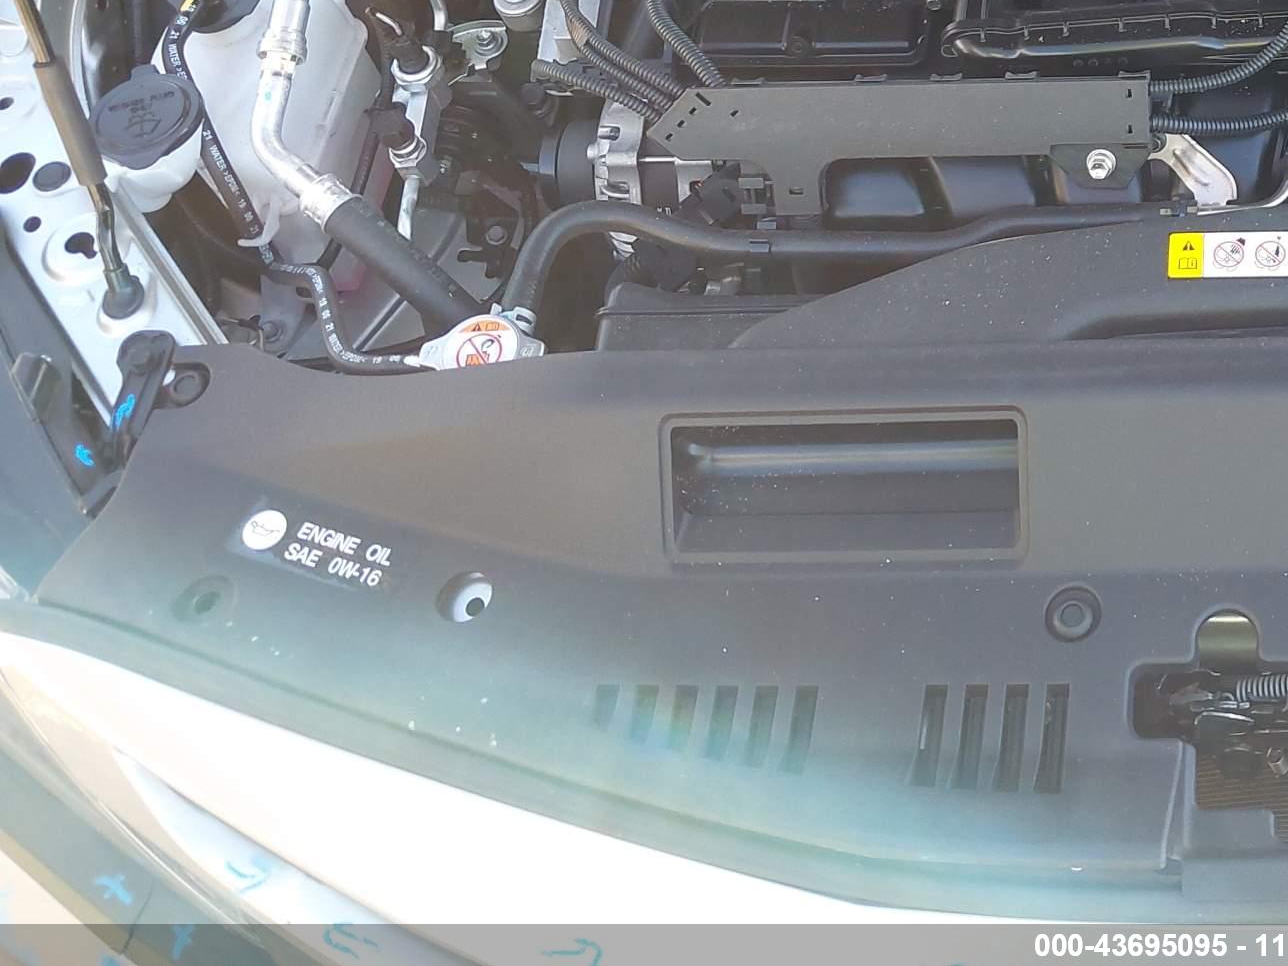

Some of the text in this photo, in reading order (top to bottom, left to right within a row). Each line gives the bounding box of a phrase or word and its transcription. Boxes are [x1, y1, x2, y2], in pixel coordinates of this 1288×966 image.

[168, 43, 182, 67] WATER
[202, 129, 214, 141] 21
[209, 144, 226, 172] WATER
[284, 542, 383, 587] SAE 0W-16
[297, 521, 393, 567] ENGINE OIL
